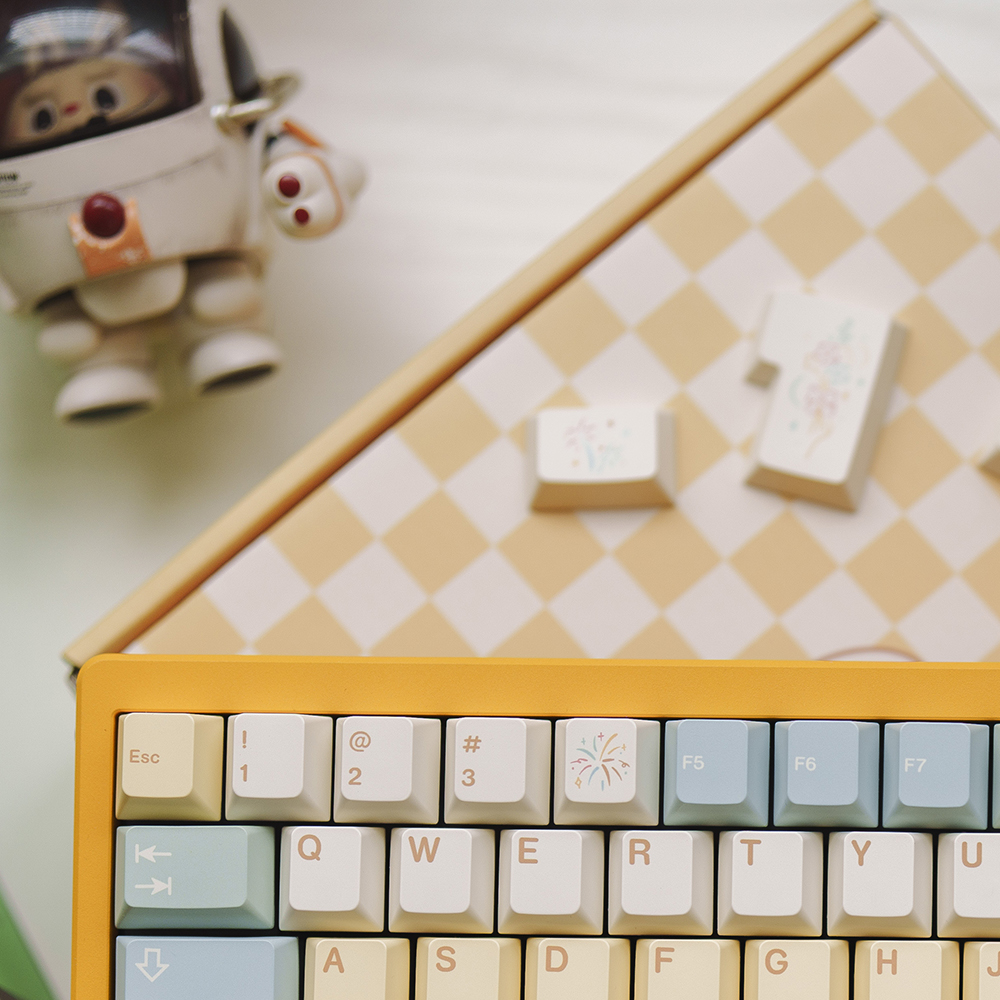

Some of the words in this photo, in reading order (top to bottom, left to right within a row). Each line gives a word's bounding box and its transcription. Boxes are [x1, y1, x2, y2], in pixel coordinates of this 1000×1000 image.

[242, 729, 248, 749] !
[349, 730, 372, 753] @
[462, 735, 482, 754] #
[129, 749, 160, 764] Esc
[682, 755, 705, 771] F5
[794, 756, 817, 772] F6
[904, 757, 927, 773] F7
[239, 763, 248, 783] 1
[348, 767, 362, 786] 2
[461, 768, 476, 787] 3
[297, 833, 322, 862] Q
[407, 835, 441, 864] W
[518, 836, 539, 865] E
[628, 838, 651, 866] R
[739, 838, 762, 866] T
[851, 839, 872, 867] Y
[961, 841, 983, 869] U
[322, 946, 345, 974] A
[435, 945, 457, 973] S
[545, 945, 569, 973] D
[654, 946, 676, 974] F
[764, 948, 789, 975] G
[876, 948, 898, 976] H
